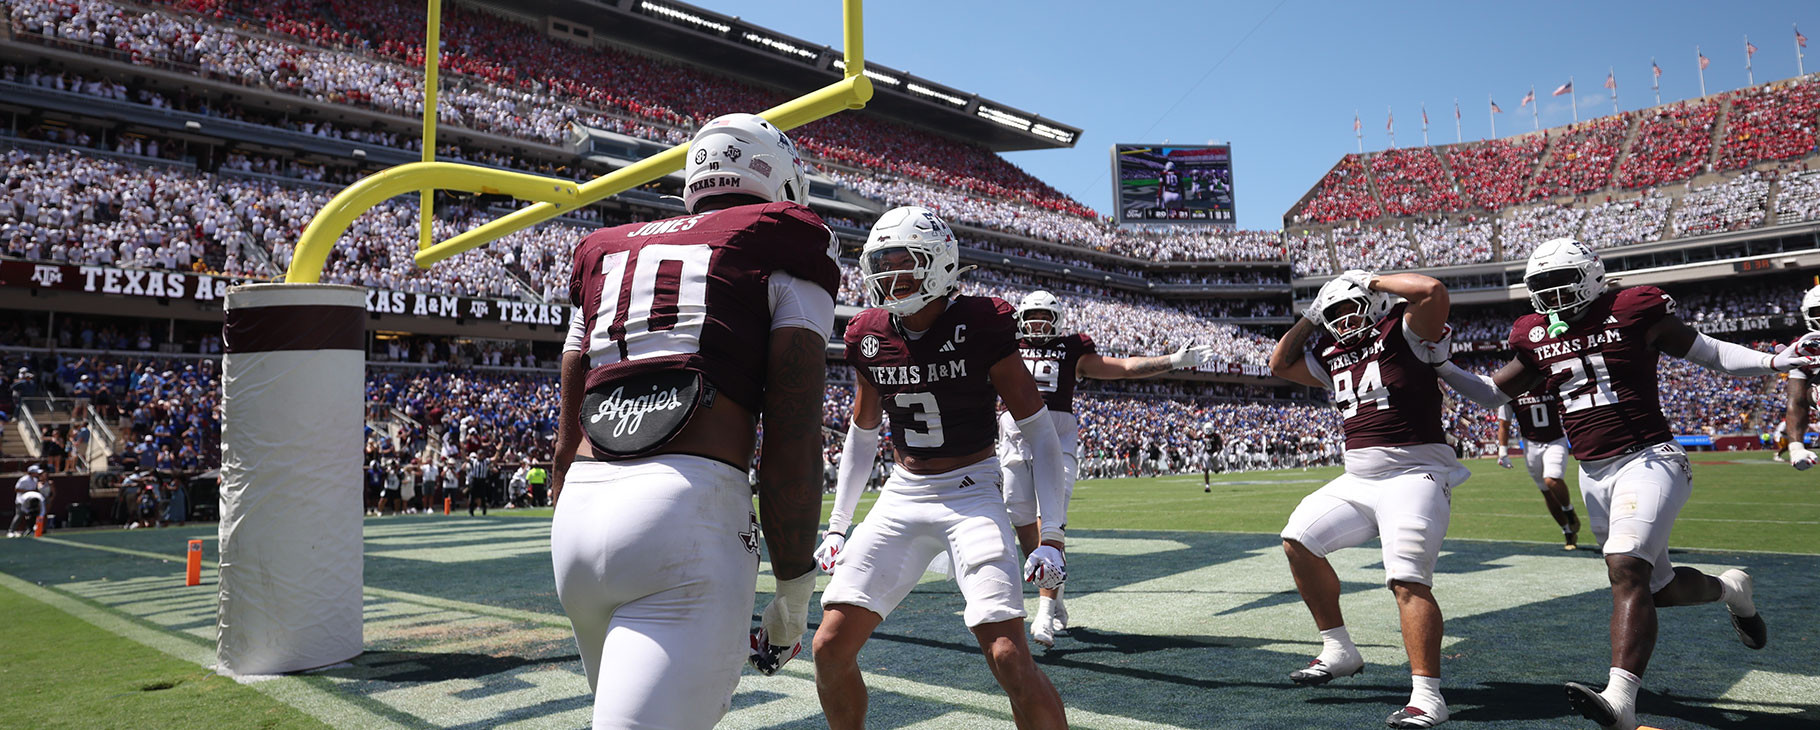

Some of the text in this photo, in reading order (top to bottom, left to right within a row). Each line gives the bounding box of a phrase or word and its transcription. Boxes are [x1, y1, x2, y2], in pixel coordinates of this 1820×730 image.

[709, 161, 719, 171] 10
[689, 177, 740, 193] TEXAS A&M
[627, 214, 704, 237] JONES
[79, 266, 226, 300] TEXAS A&
[365, 290, 459, 317] XAS A&M
[497, 301, 562, 325] TEXAS
[586, 244, 713, 363] 10
[954, 325, 966, 343] C
[1696, 318, 1770, 334] TEXAS A&M
[862, 337, 878, 356] SEC
[1019, 348, 1042, 358] XAS
[1534, 337, 1582, 361] TEXAS
[1587, 329, 1622, 348] A&M
[869, 359, 967, 385] TEXAS A&M
[1327, 351, 1359, 372] TEXAS
[1333, 360, 1391, 420] 94
[1551, 353, 1619, 413] 21
[590, 385, 682, 438] Aggies
[1518, 396, 1541, 405] TEXAS
[895, 391, 945, 448] 3
[1530, 403, 1549, 428] 0
